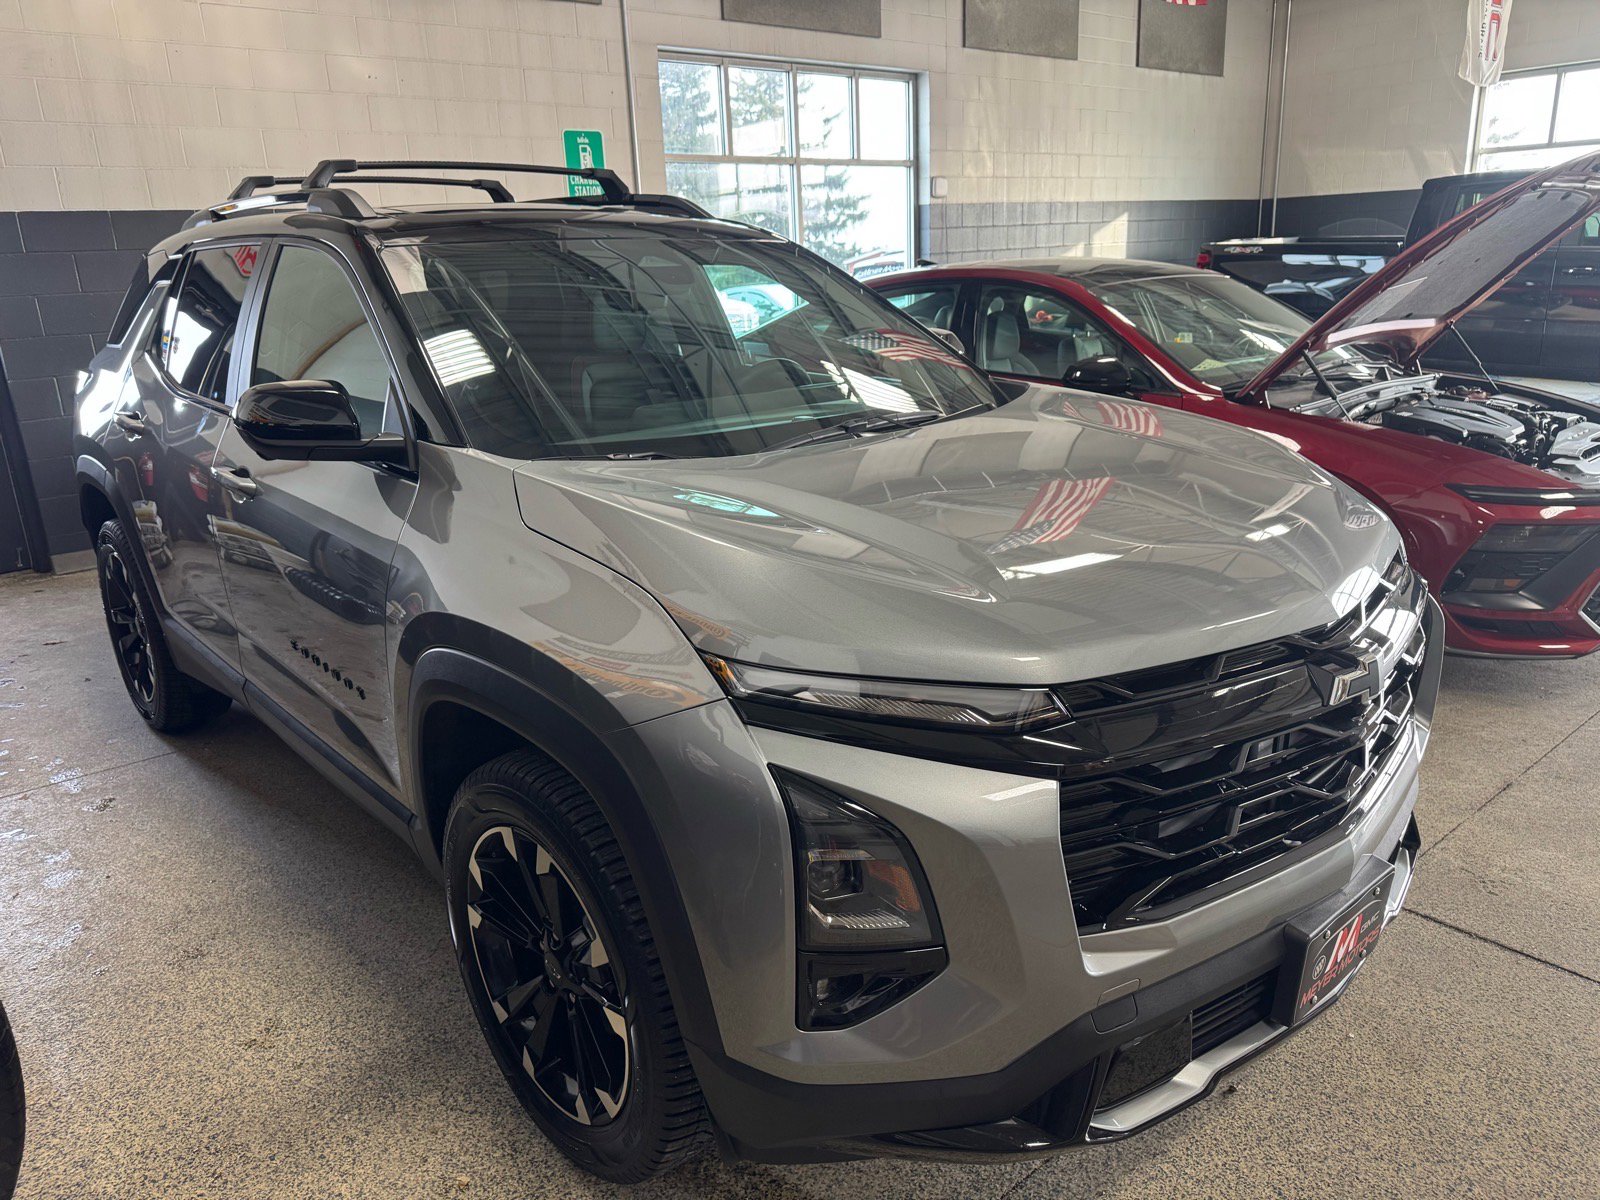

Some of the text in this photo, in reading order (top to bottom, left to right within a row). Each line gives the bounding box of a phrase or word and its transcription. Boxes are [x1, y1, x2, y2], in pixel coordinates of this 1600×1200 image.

[574, 186, 603, 196] STATION
[1299, 924, 1381, 1009] MEYER MOTORS
